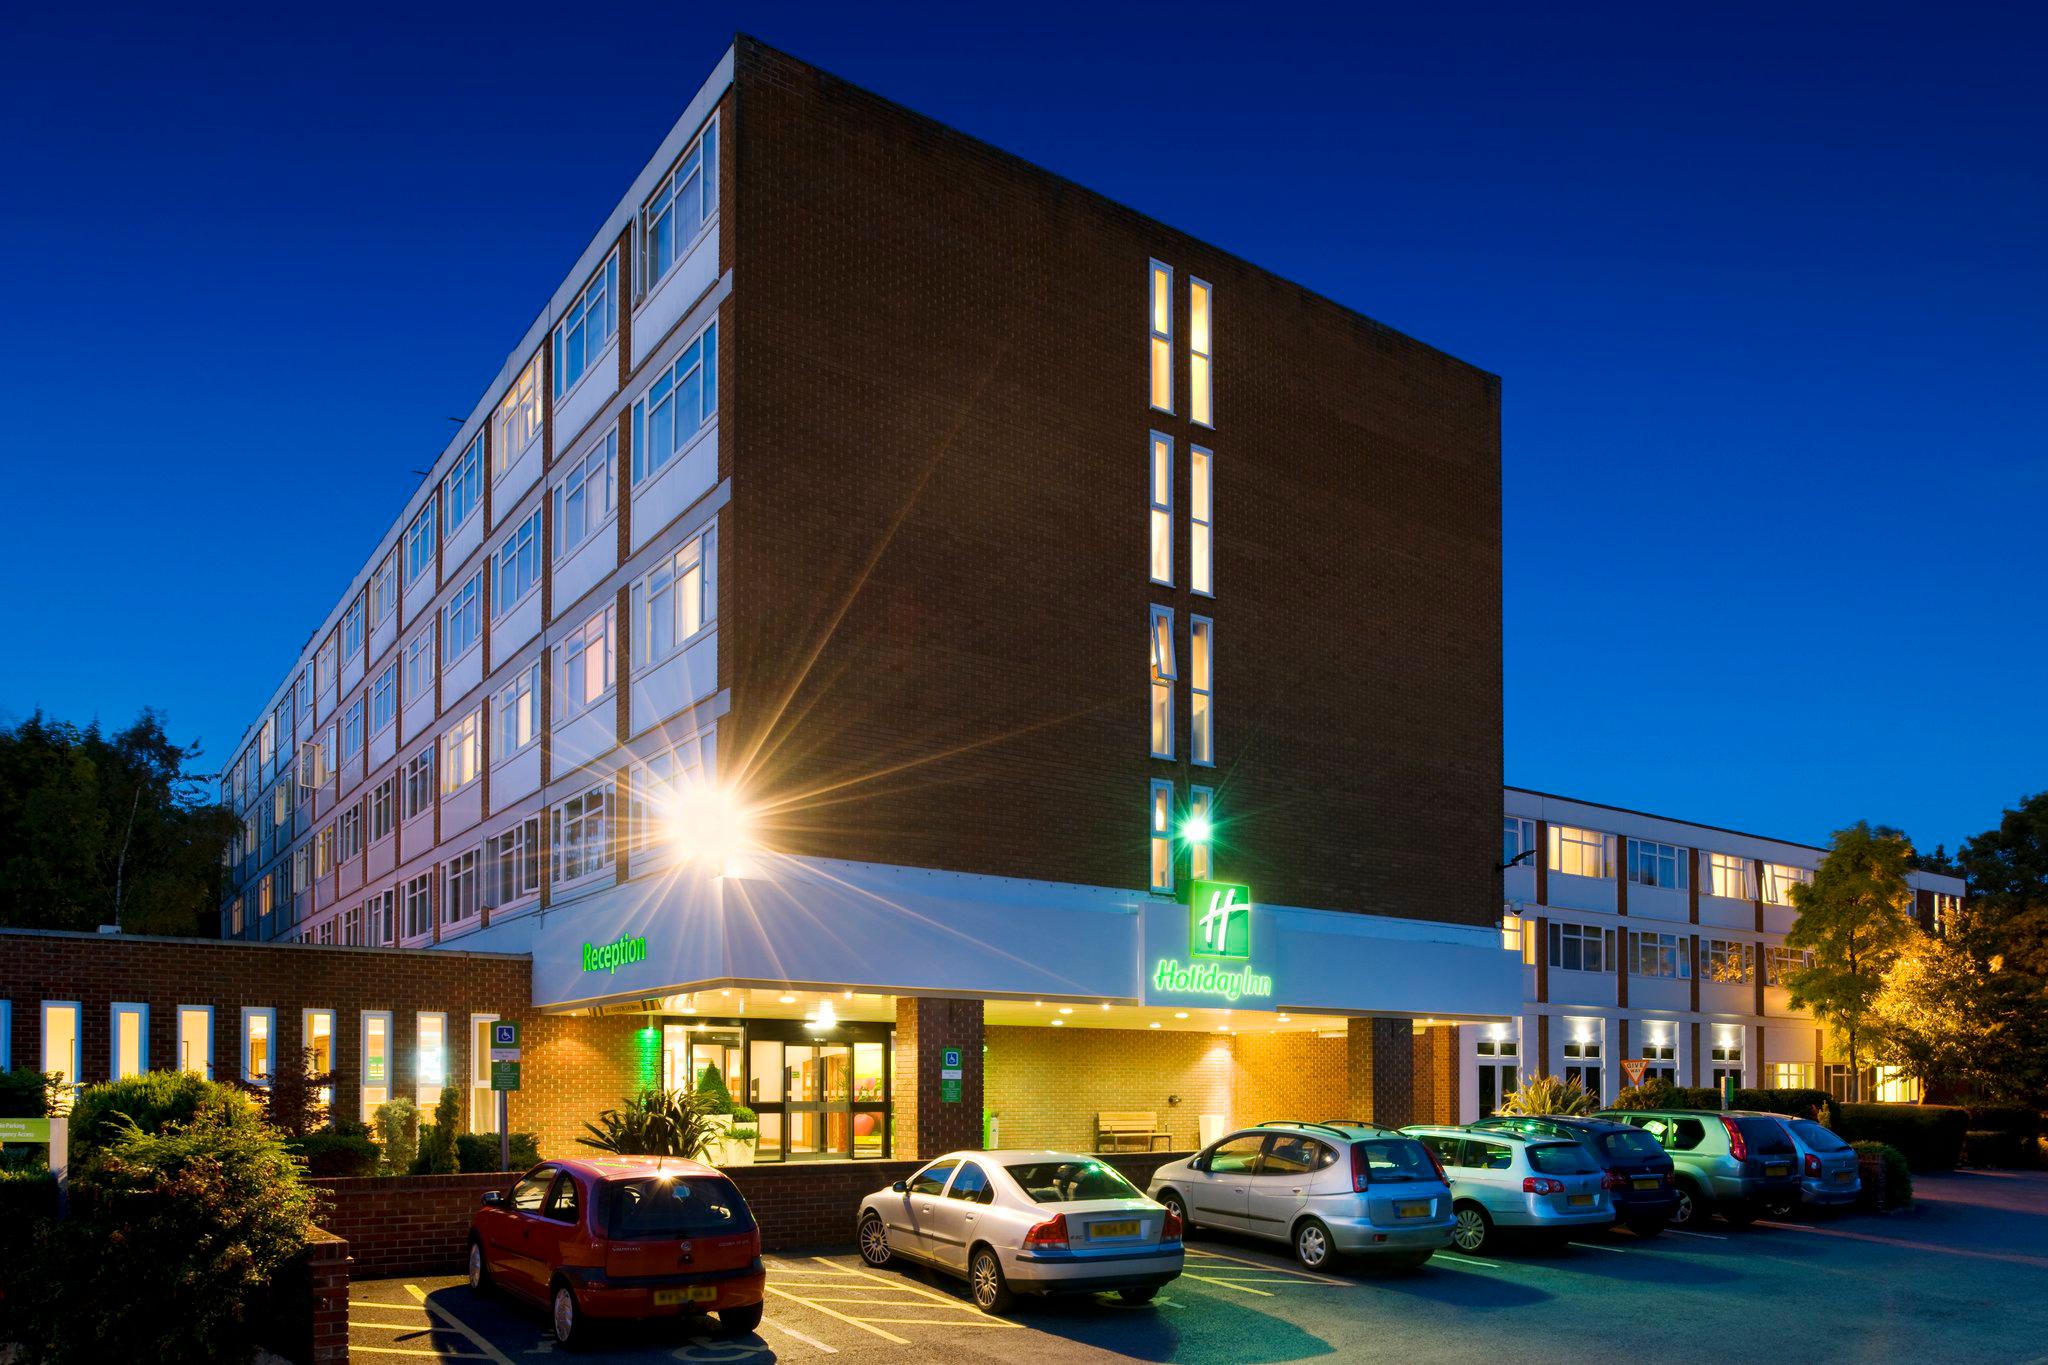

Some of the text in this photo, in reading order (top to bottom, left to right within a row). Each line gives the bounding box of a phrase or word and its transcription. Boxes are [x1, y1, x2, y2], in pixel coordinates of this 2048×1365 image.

[582, 931, 646, 975] Reception
[1154, 959, 1272, 1000] Holiday Inn
